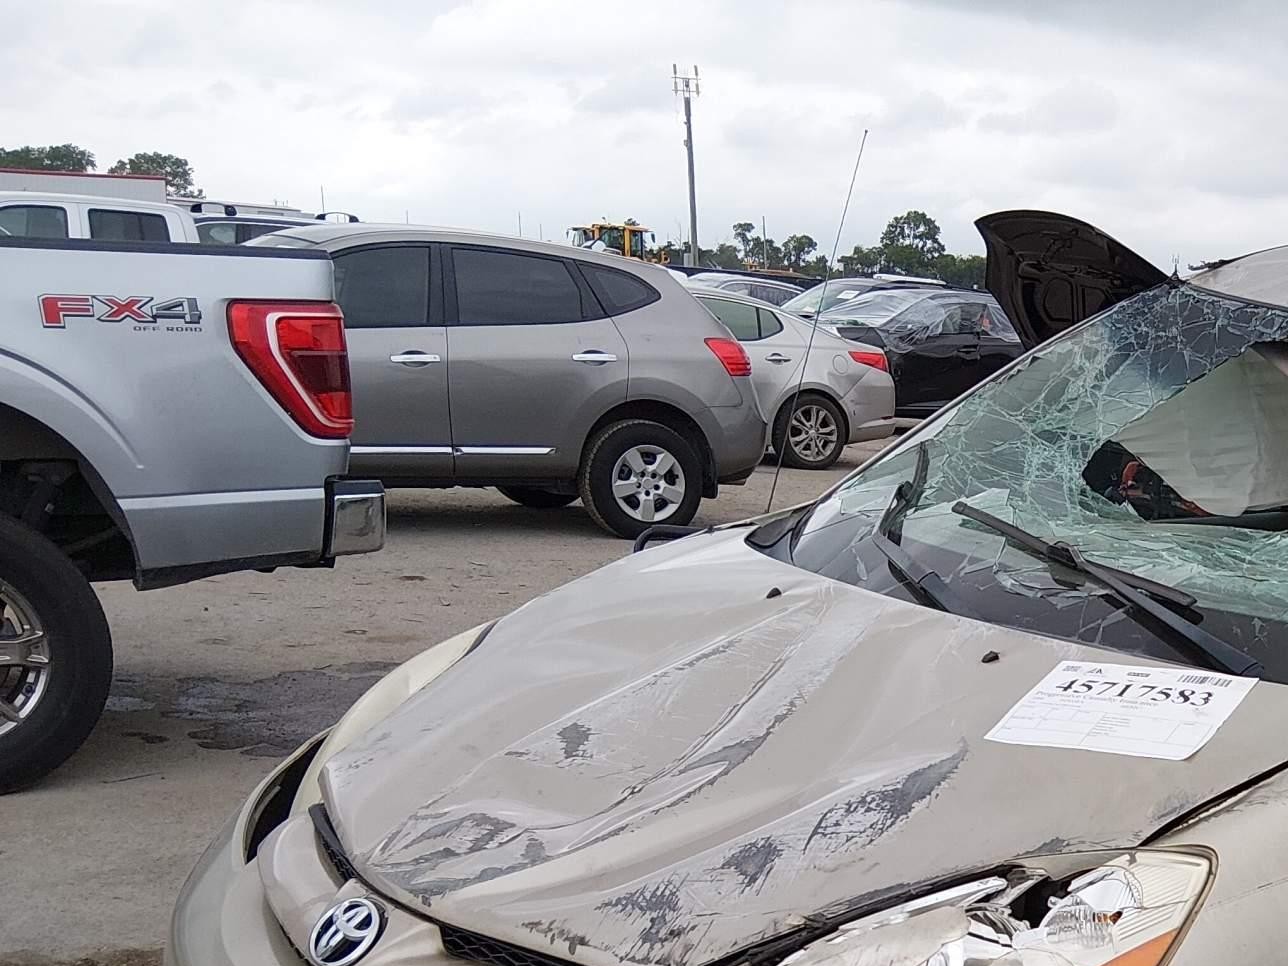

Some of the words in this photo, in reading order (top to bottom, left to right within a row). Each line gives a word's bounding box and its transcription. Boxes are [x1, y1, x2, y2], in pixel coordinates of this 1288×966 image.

[38, 293, 202, 329] FX4
[133, 325, 161, 333] OFF
[1055, 678, 1213, 707] 45717583
